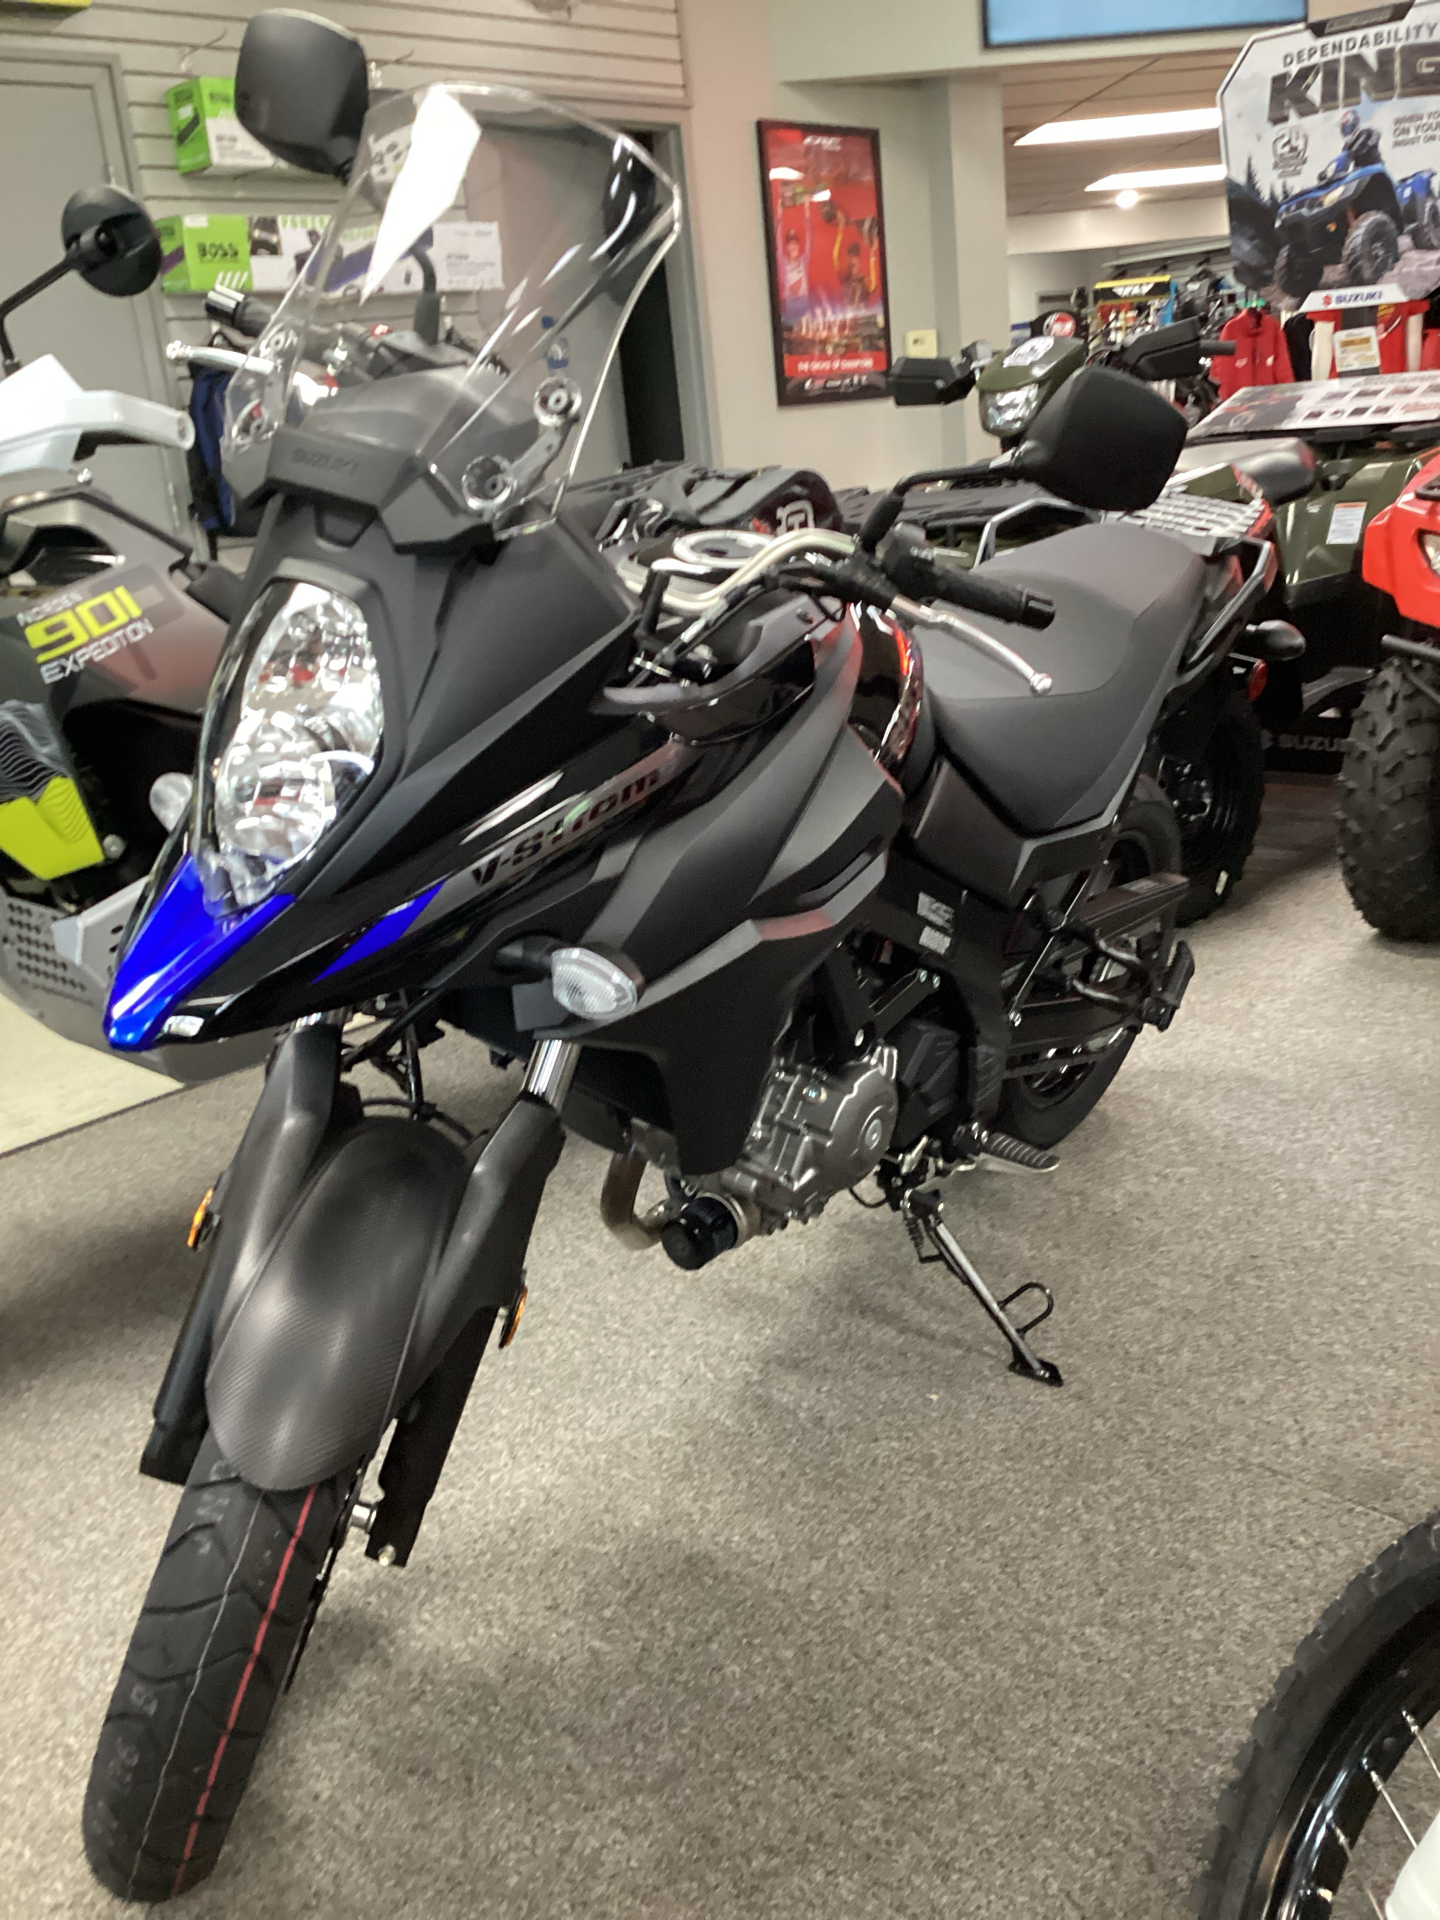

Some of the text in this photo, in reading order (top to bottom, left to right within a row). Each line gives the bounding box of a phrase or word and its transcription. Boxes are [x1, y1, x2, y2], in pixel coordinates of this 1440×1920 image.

[1283, 22, 1438, 68] DEPENDABILITY
[1334, 290, 1383, 305] SUZUKI
[24, 584, 143, 665] 901
[40, 616, 155, 685] EXPEDITION
